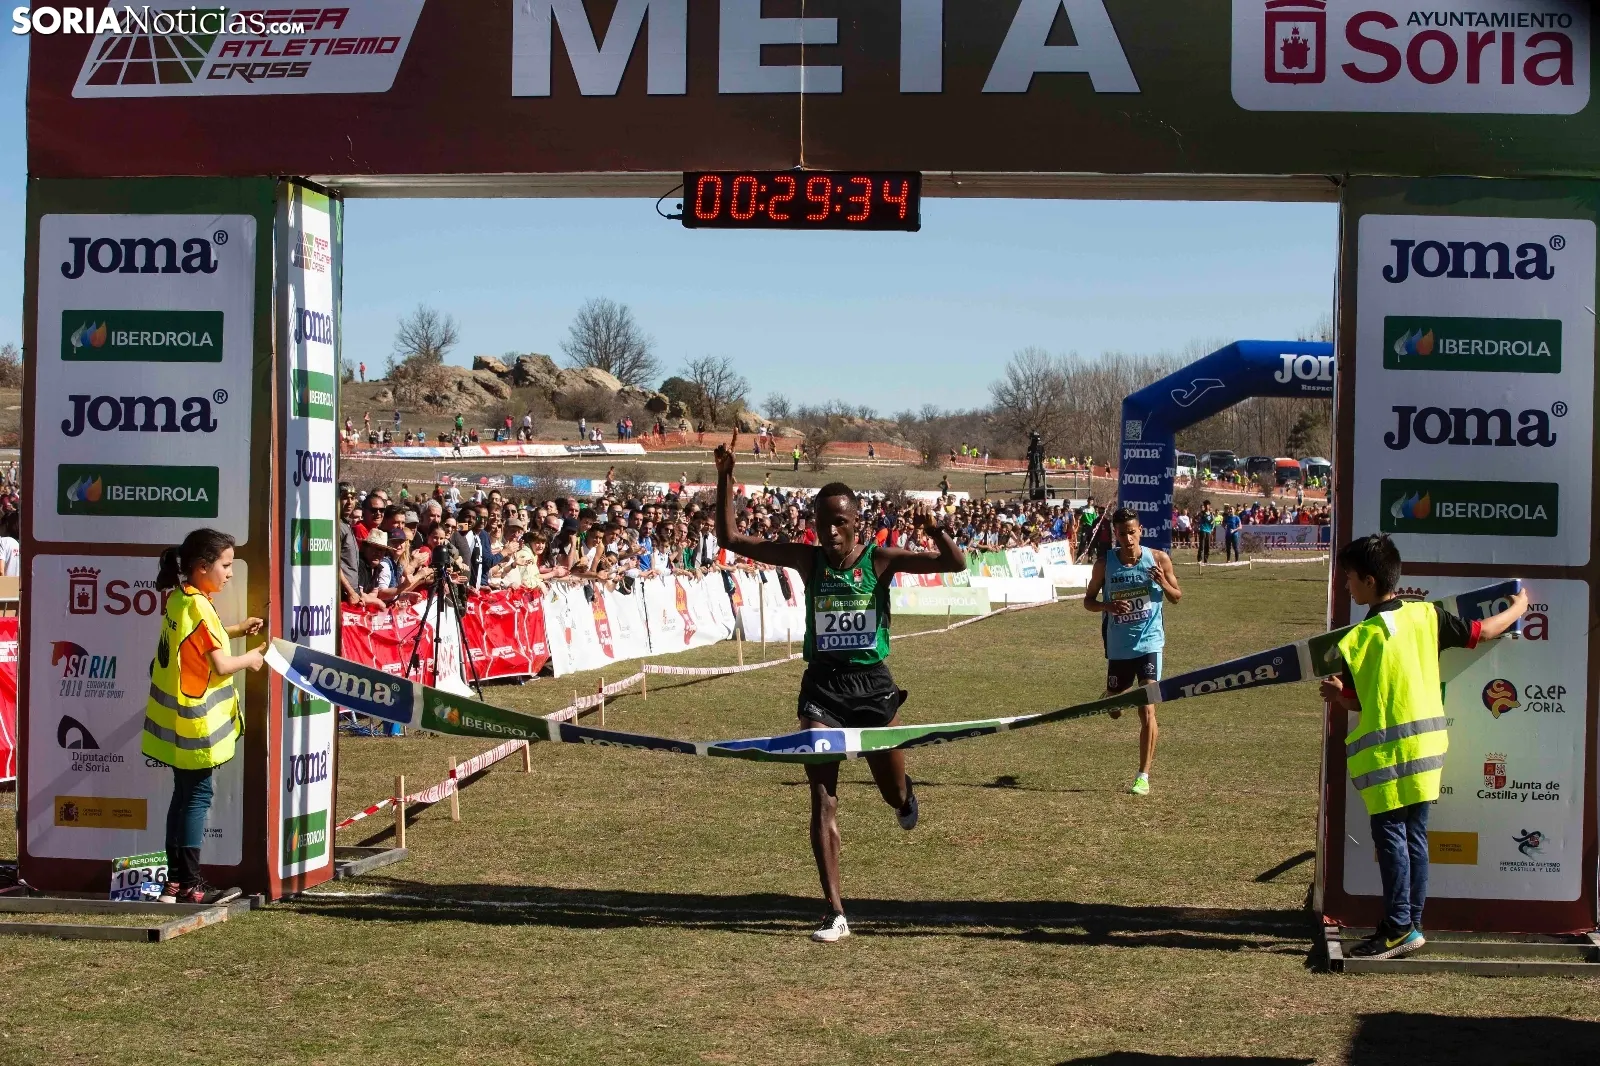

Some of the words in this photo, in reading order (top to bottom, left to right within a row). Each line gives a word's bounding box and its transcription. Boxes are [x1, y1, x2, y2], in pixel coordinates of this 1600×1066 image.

[1406, 12, 1573, 29] AYUNTAMIENTO
[218, 37, 402, 58] ATLETISMO
[1341, 10, 1575, 86] Soria
[206, 61, 312, 84] CROSS
[694, 175, 909, 222] 00:29:34
[111, 330, 213, 347] IBERDROLA
[1439, 339, 1551, 357] IBERDROLA
[106, 484, 209, 502] IBERDROLA
[1435, 502, 1548, 520] IBERDROLA
[824, 612, 866, 632] 260
[84, 690, 96, 698] CITY
[106, 690, 125, 699] SPORT
[461, 715, 540, 739] IBERDROLA
[72, 751, 124, 763] Diputación
[72, 762, 83, 771] de
[85, 762, 110, 772] Soria
[1509, 780, 1541, 791] Junta
[1545, 780, 1560, 790] de
[1477, 789, 1518, 800] Castilla
[1520, 793, 1529, 802] y
[1531, 790, 1560, 801] León
[130, 857, 168, 866] IBERDROLA
[117, 867, 167, 889] 1036
